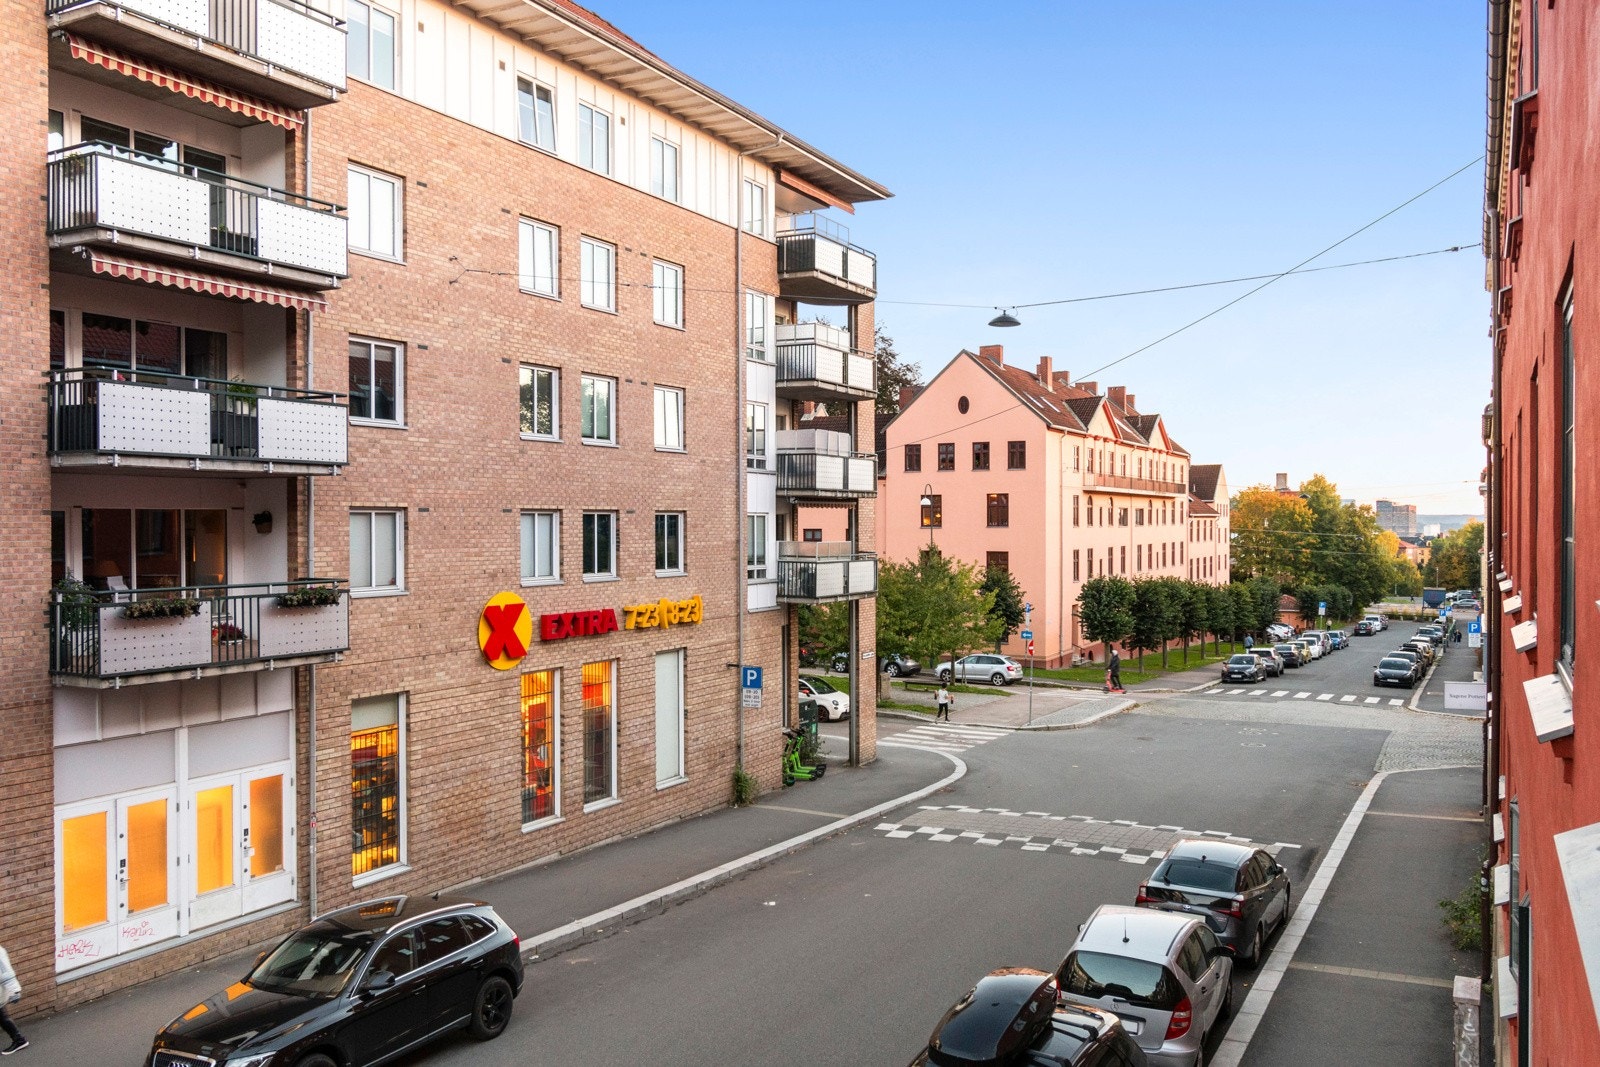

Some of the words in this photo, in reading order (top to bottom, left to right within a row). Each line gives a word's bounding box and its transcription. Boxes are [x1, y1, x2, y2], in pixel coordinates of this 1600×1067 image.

[483, 603, 528, 661] X
[541, 609, 618, 641] EXTRA
[624, 603, 660, 630] 7-23
[659, 595, 703, 629] (8-23)
[1471, 624, 1478, 632] P
[747, 670, 757, 685] P
